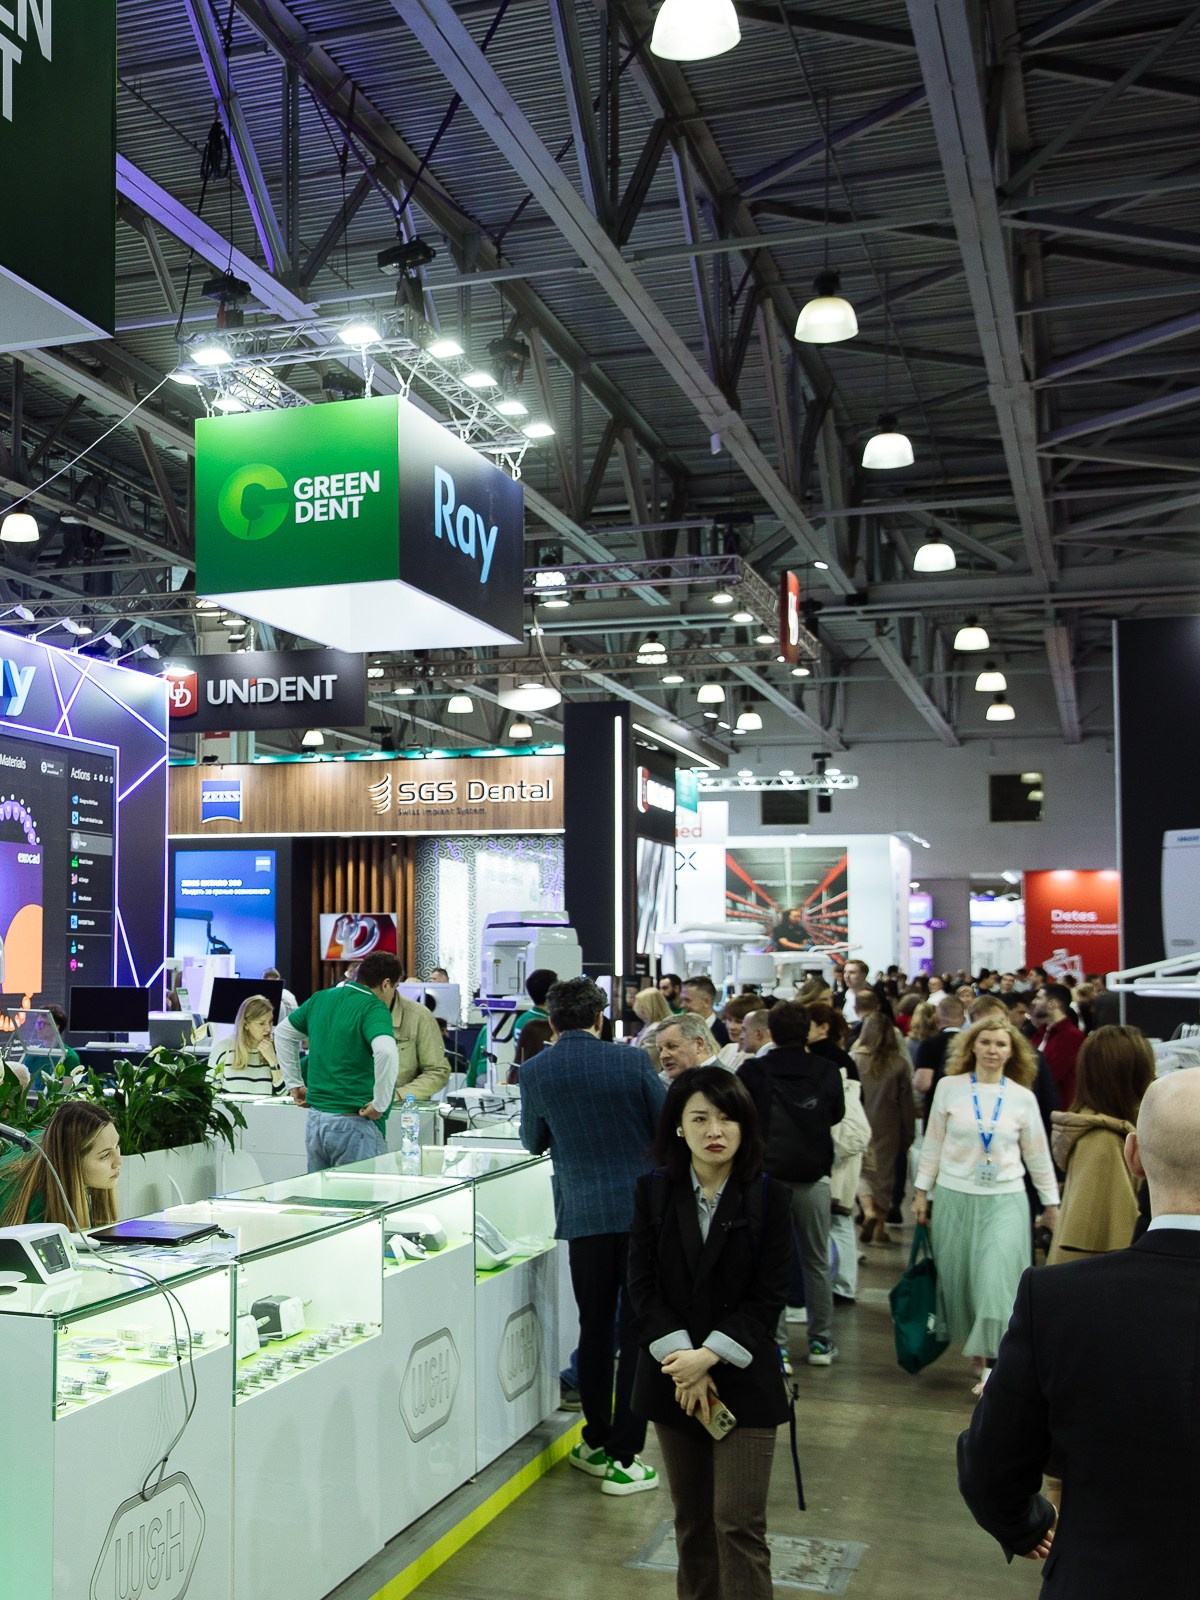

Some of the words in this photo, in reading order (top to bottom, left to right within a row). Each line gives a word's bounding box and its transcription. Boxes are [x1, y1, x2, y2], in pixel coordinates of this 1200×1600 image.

[293, 470, 380, 500] GREEN
[295, 495, 364, 523] DENT
[434, 464, 499, 584] Ray
[0, 753, 27, 770] Materials
[70, 767, 91, 781] Actions
[398, 781, 456, 803] SGS
[467, 780, 552, 802] Dental
[1050, 909, 1098, 922] Detes
